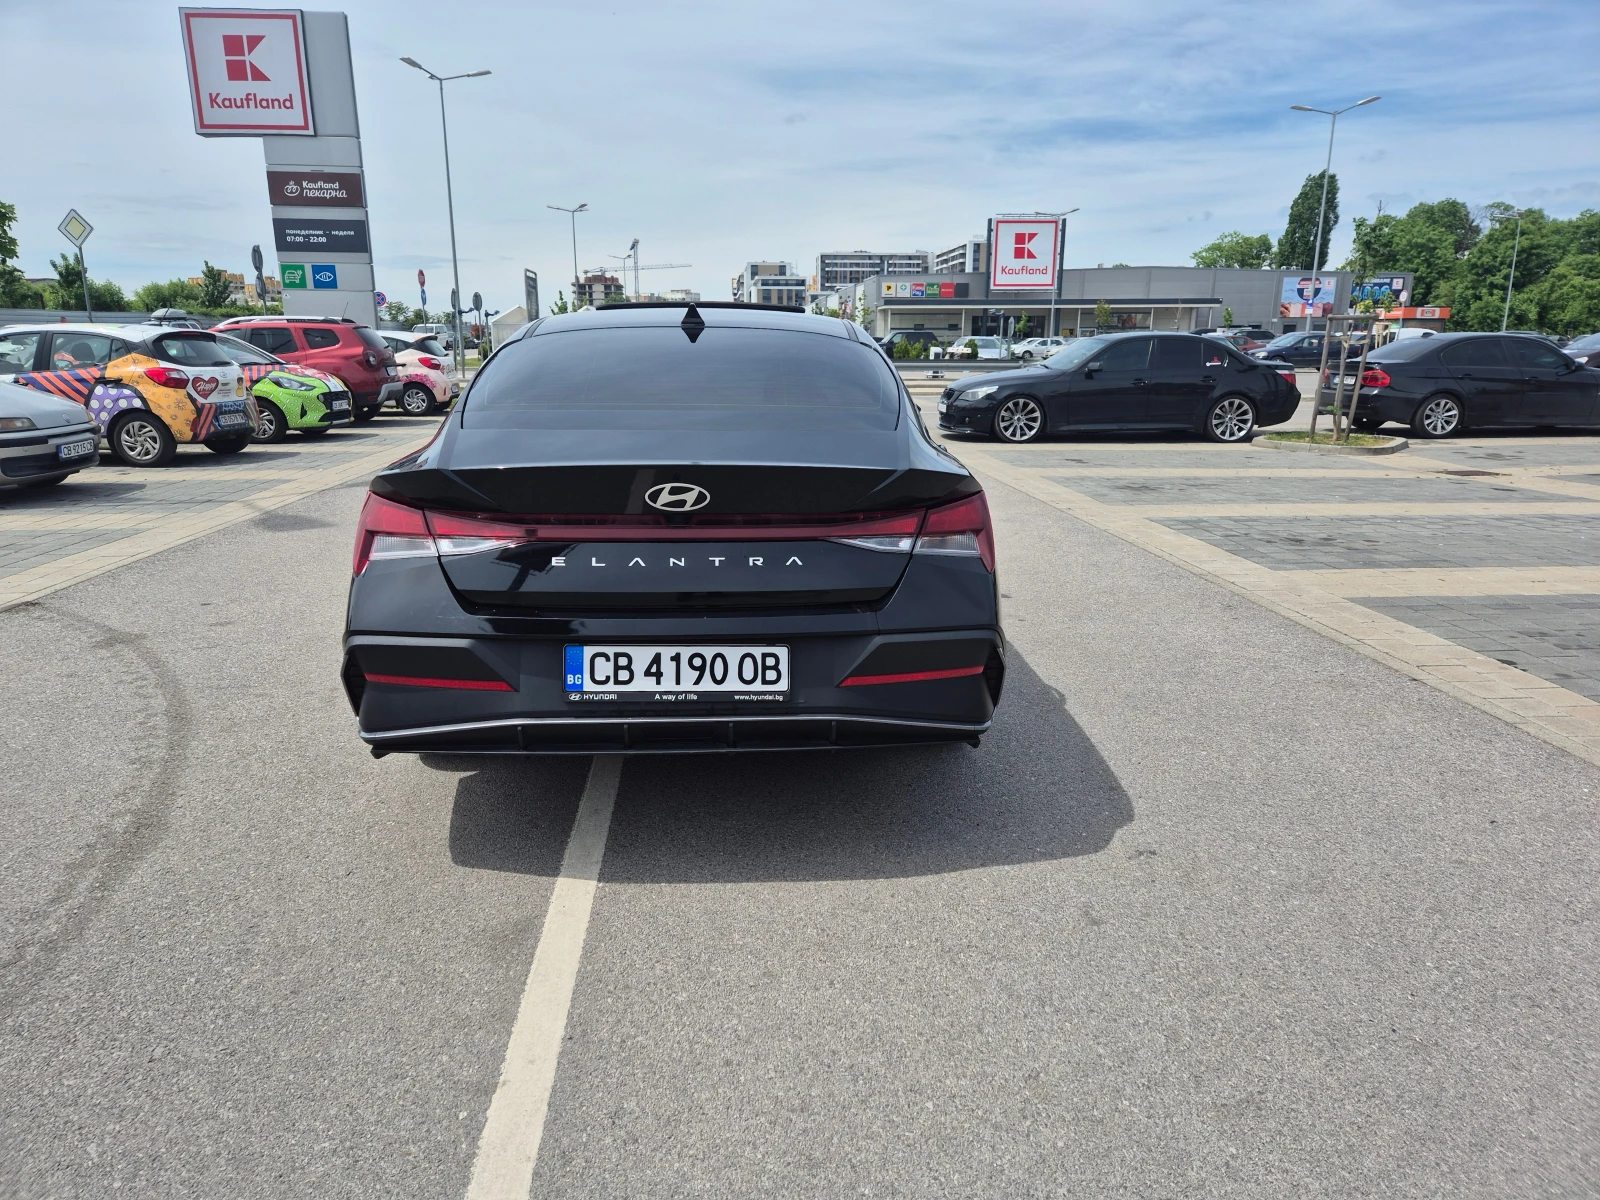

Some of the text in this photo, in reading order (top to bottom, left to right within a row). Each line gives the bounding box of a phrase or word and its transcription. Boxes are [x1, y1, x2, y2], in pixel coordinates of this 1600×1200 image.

[208, 92, 294, 110] Kaufland
[302, 180, 339, 189] Kaufland
[303, 189, 347, 199] пекарна
[1001, 265, 1048, 275] Kaufland
[63, 446, 71, 456] CB
[73, 443, 86, 455] 9215
[551, 556, 803, 567] ELANTRA
[589, 652, 782, 685] CB 4190 OB
[567, 674, 582, 684] BG
[734, 694, 783, 702] www.hyundai.bg
